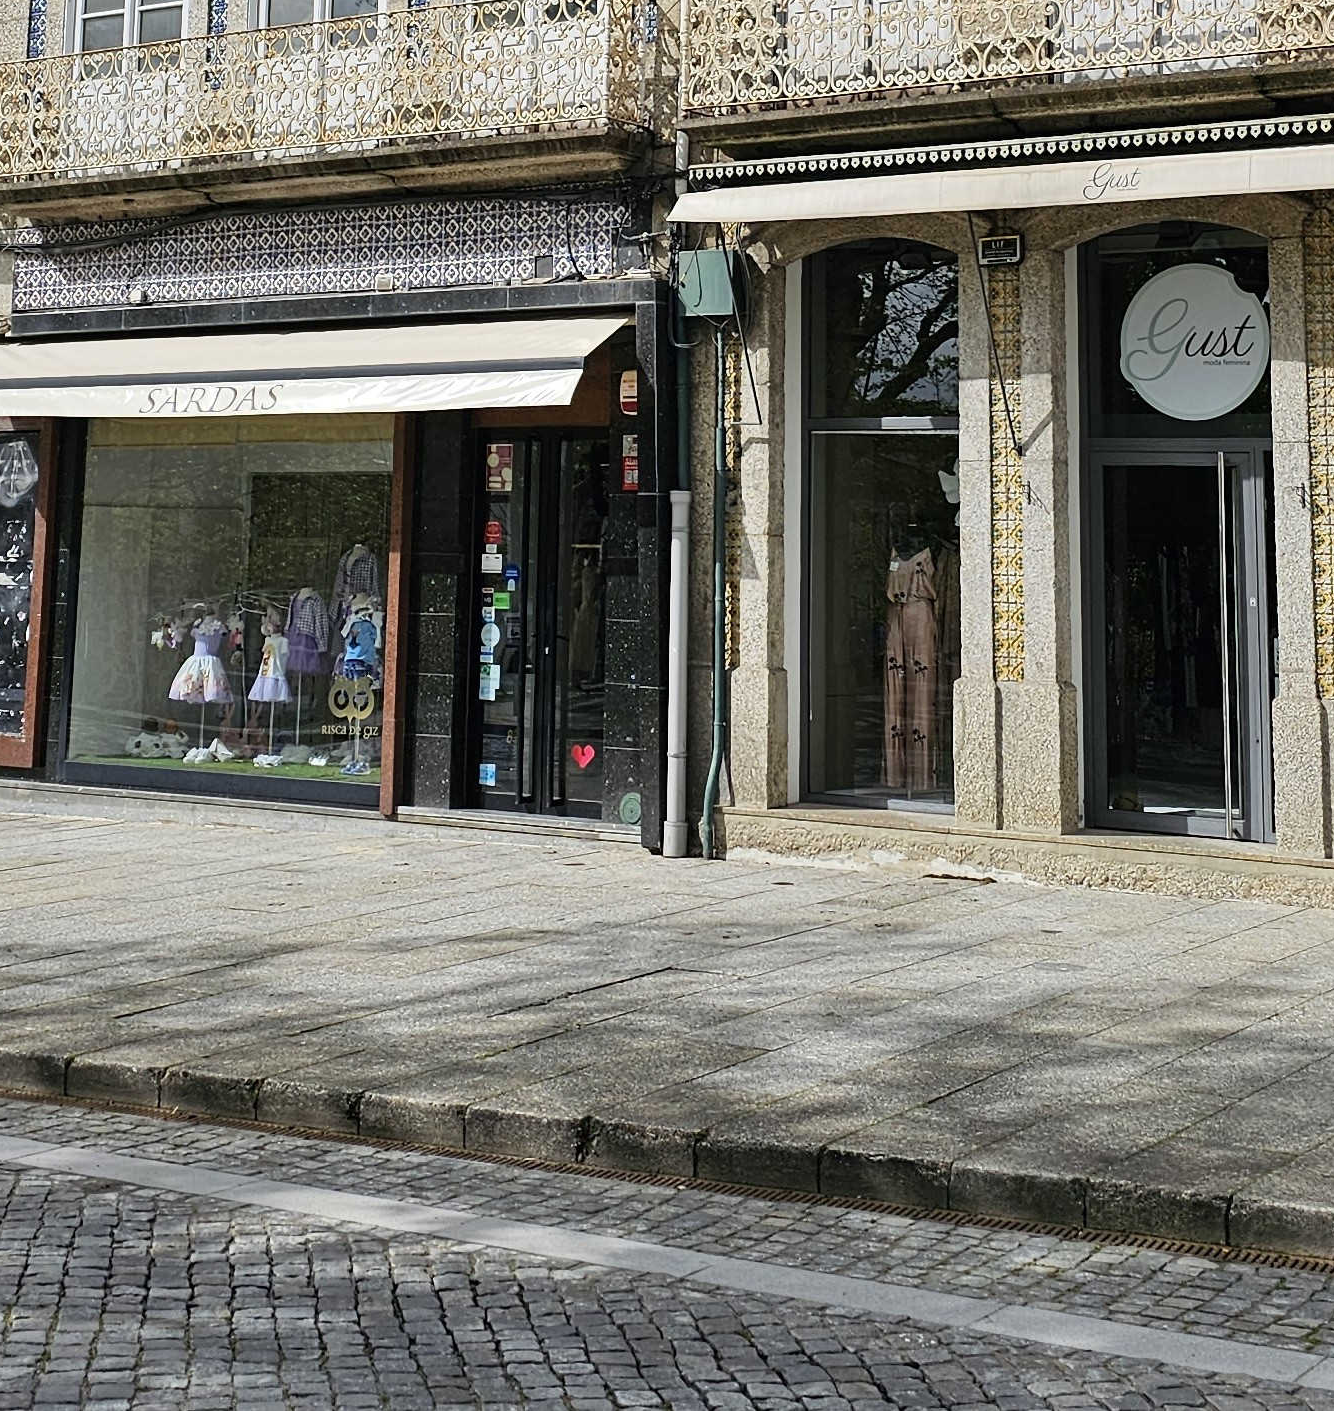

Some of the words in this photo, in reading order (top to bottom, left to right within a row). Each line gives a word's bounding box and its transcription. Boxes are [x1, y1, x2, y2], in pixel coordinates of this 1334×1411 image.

[1082, 162, 1142, 201] Gust
[1125, 297, 1257, 382] Gust
[138, 383, 284, 414] SARDAS
